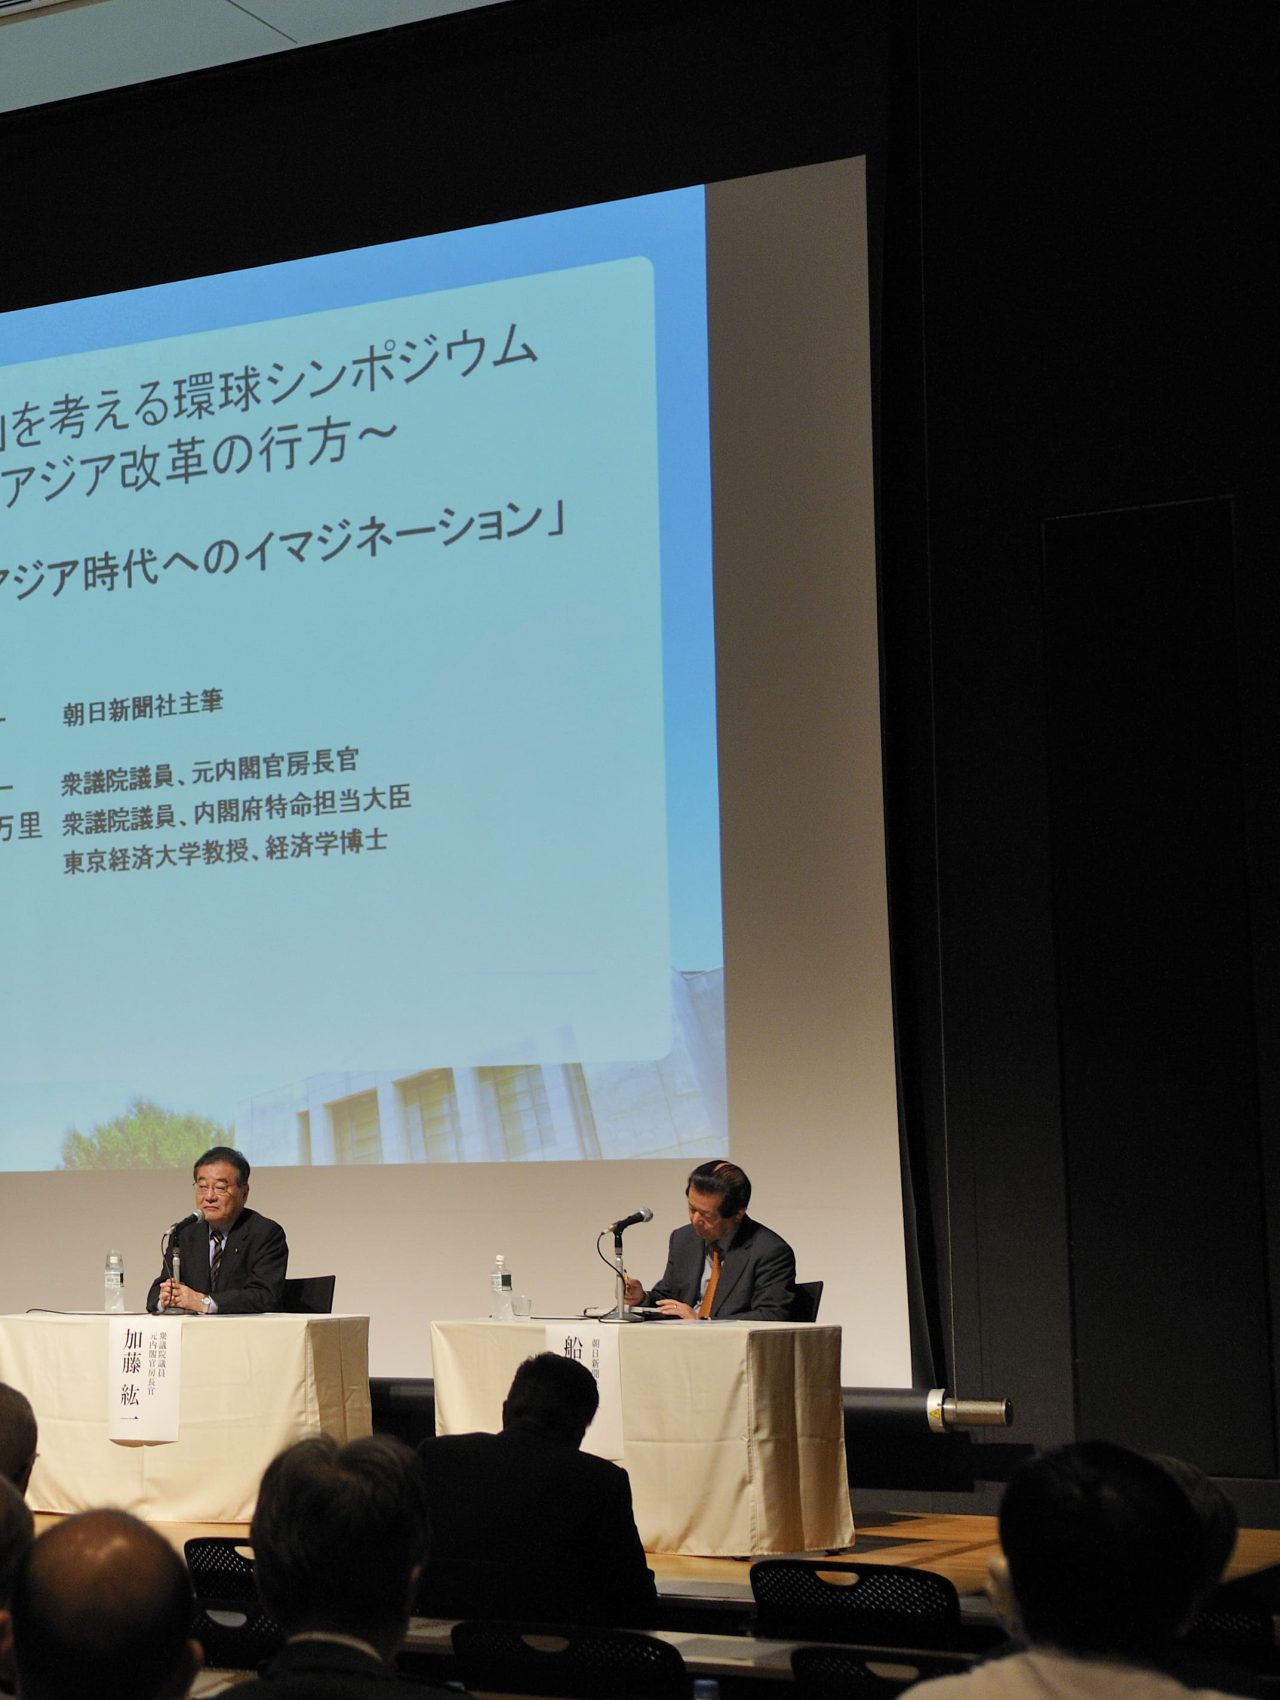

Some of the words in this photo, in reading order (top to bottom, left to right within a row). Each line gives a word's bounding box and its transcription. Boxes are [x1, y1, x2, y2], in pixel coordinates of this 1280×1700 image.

[63, 688, 224, 727] 朝日新聞社主筆
[61, 745, 360, 797] 衆議院議員、元内閣官房長官
[62, 784, 412, 836] 衆議院議員、内閣府特命担当大臣
[63, 827, 388, 875] 東京経済大学教授、経済学博士
[122, 1328, 142, 1374] 加藤
[120, 1384, 140, 1420] 紘一
